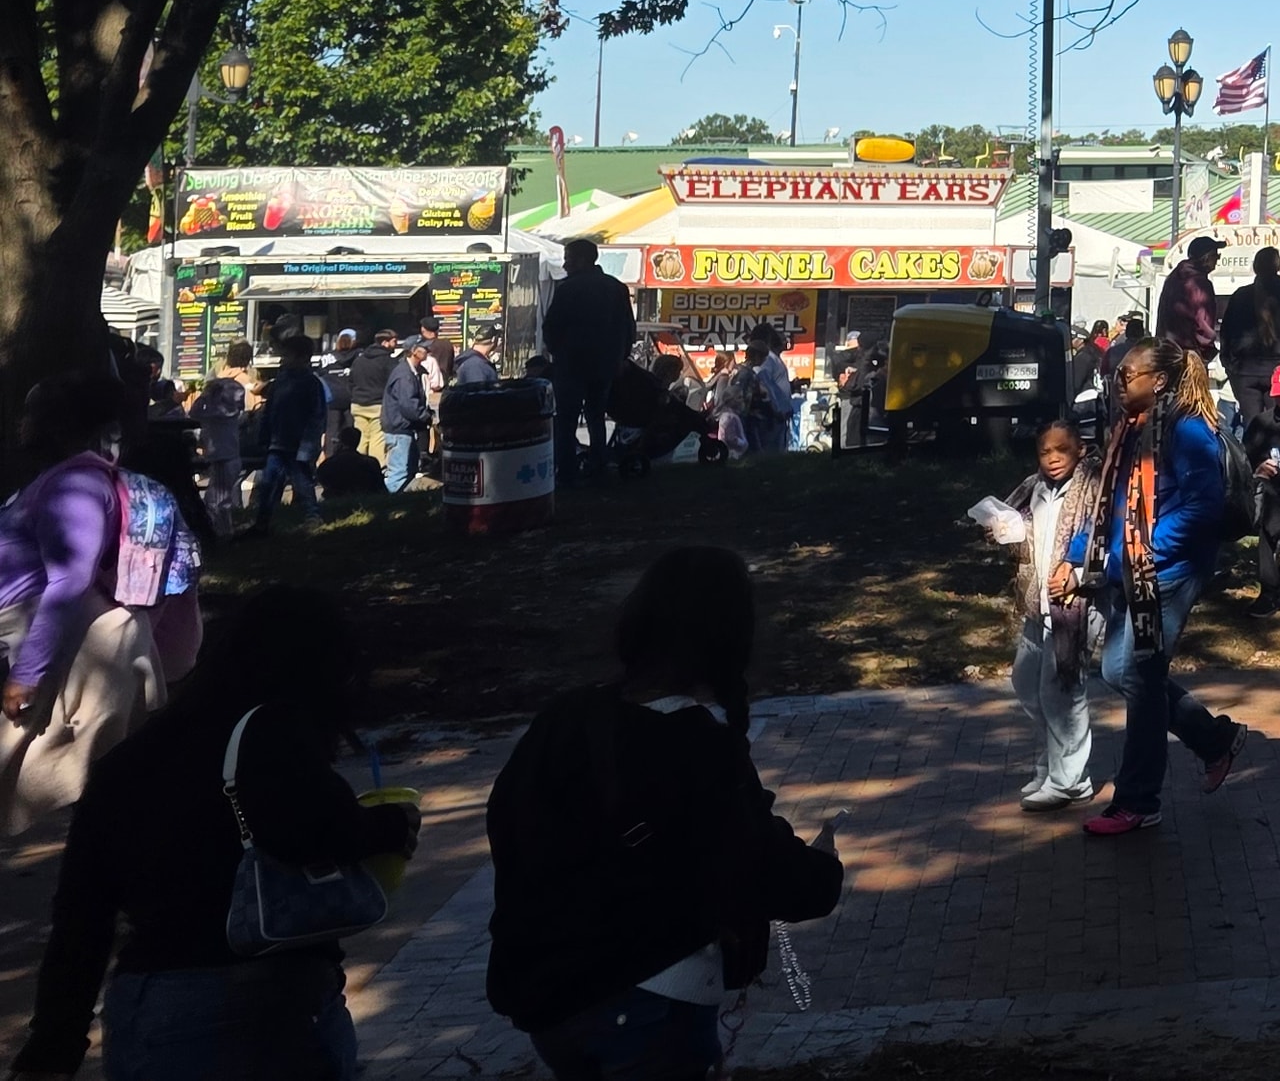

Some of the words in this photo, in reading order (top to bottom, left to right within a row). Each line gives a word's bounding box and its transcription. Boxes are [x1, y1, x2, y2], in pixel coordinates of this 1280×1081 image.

[186, 172, 239, 191] Serving
[391, 170, 425, 183] Vibes
[430, 171, 462, 184] Since
[686, 180, 886, 200] ELEPHANT
[898, 181, 990, 201] EARS
[221, 192, 266, 203] Smoothies
[227, 203, 258, 211] Frozen
[428, 199, 457, 209] Vegan
[230, 212, 253, 221] Fruit
[422, 209, 452, 219] Gluten
[453, 210, 461, 218] &
[226, 222, 256, 231] Blends
[417, 219, 443, 228] Dairy
[444, 219, 464, 228] Free
[1236, 234, 1259, 246] DOG
[284, 264, 299, 272] The
[301, 264, 337, 274] Original
[339, 264, 383, 274] Pineapple
[385, 263, 407, 273] Guys
[693, 249, 834, 281] FUNNEL
[850, 250, 961, 281] CAKES
[673, 293, 771, 310] BISCOFF
[997, 381, 1031, 390] ECO360
